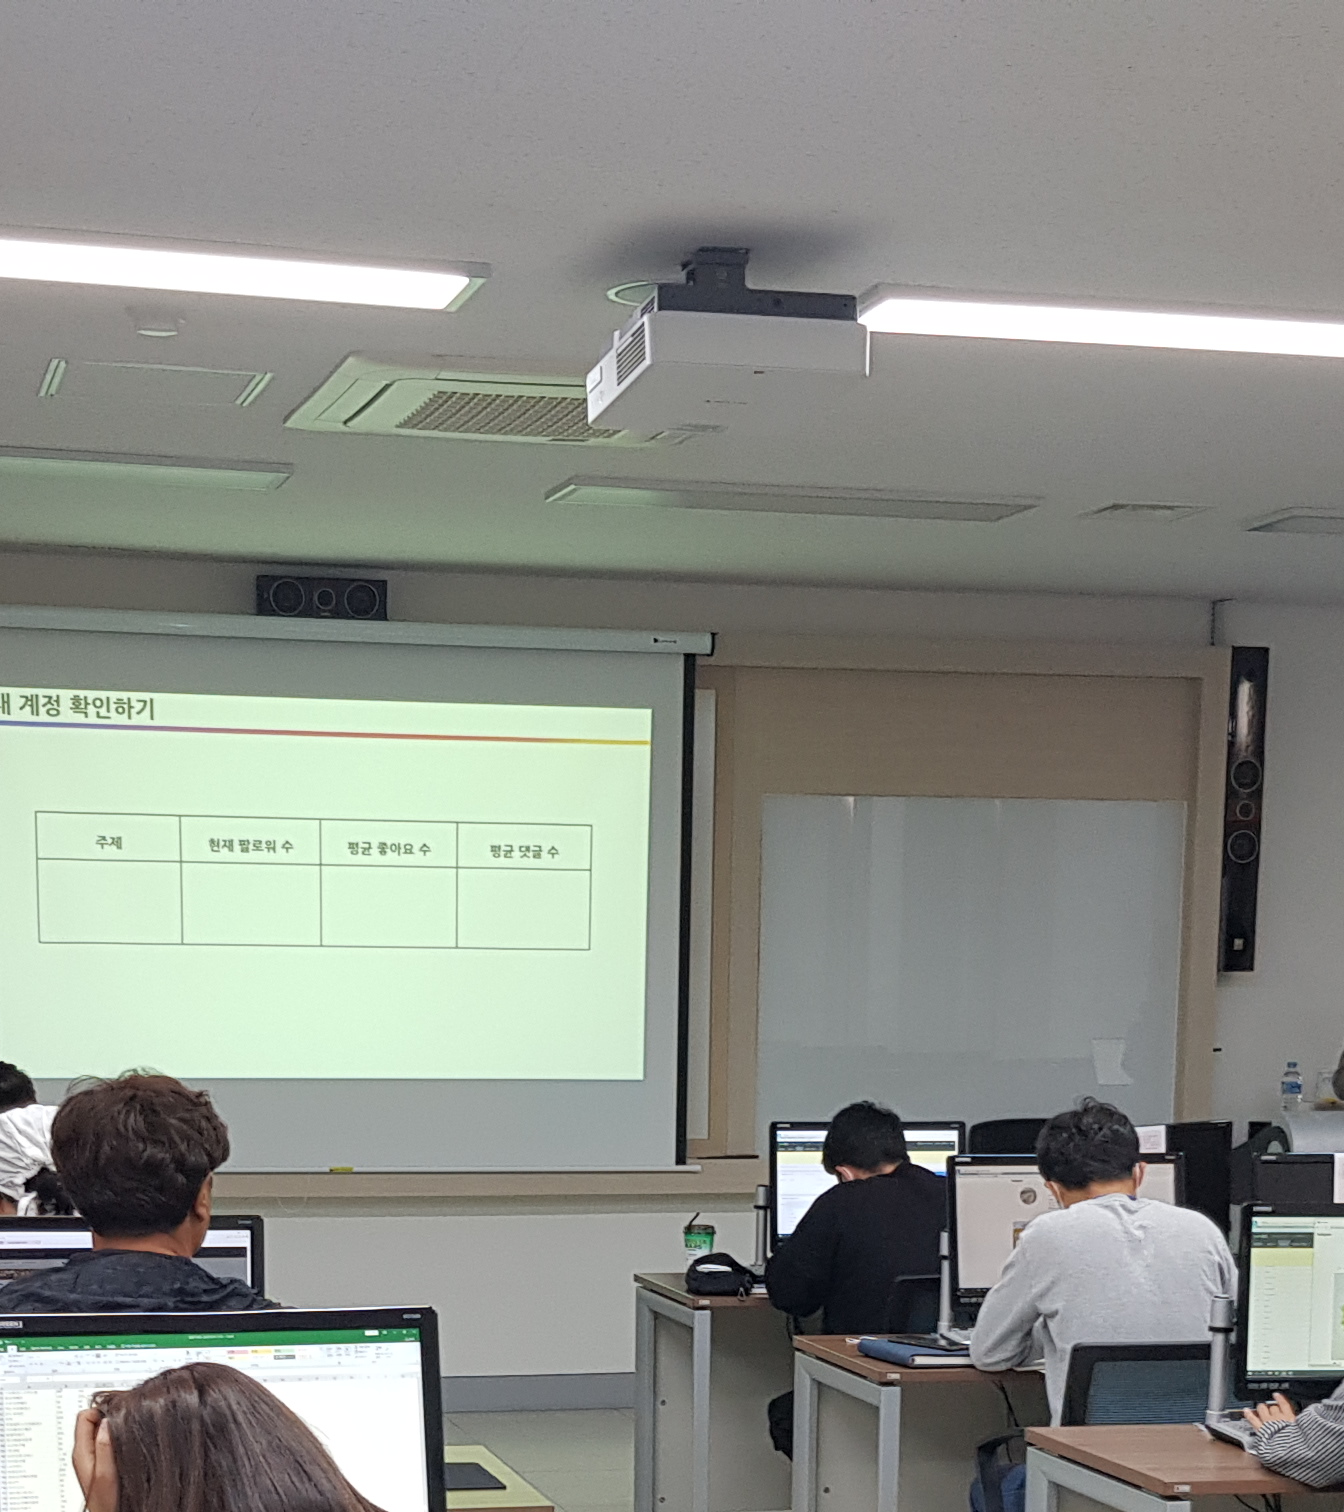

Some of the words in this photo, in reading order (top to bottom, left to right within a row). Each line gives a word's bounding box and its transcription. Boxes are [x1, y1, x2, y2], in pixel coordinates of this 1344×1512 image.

[19, 693, 62, 717] 계정
[69, 694, 155, 721] 확인하기
[95, 835, 123, 850] 주제
[208, 838, 234, 853] 현재
[238, 839, 277, 854] 팔로워
[281, 840, 294, 853] 수
[347, 841, 373, 856] 평균
[377, 842, 415, 856] 좋아요
[419, 843, 432, 856] 수
[490, 844, 515, 859] 평균
[518, 845, 543, 859] 댓글
[547, 846, 560, 859] 수
